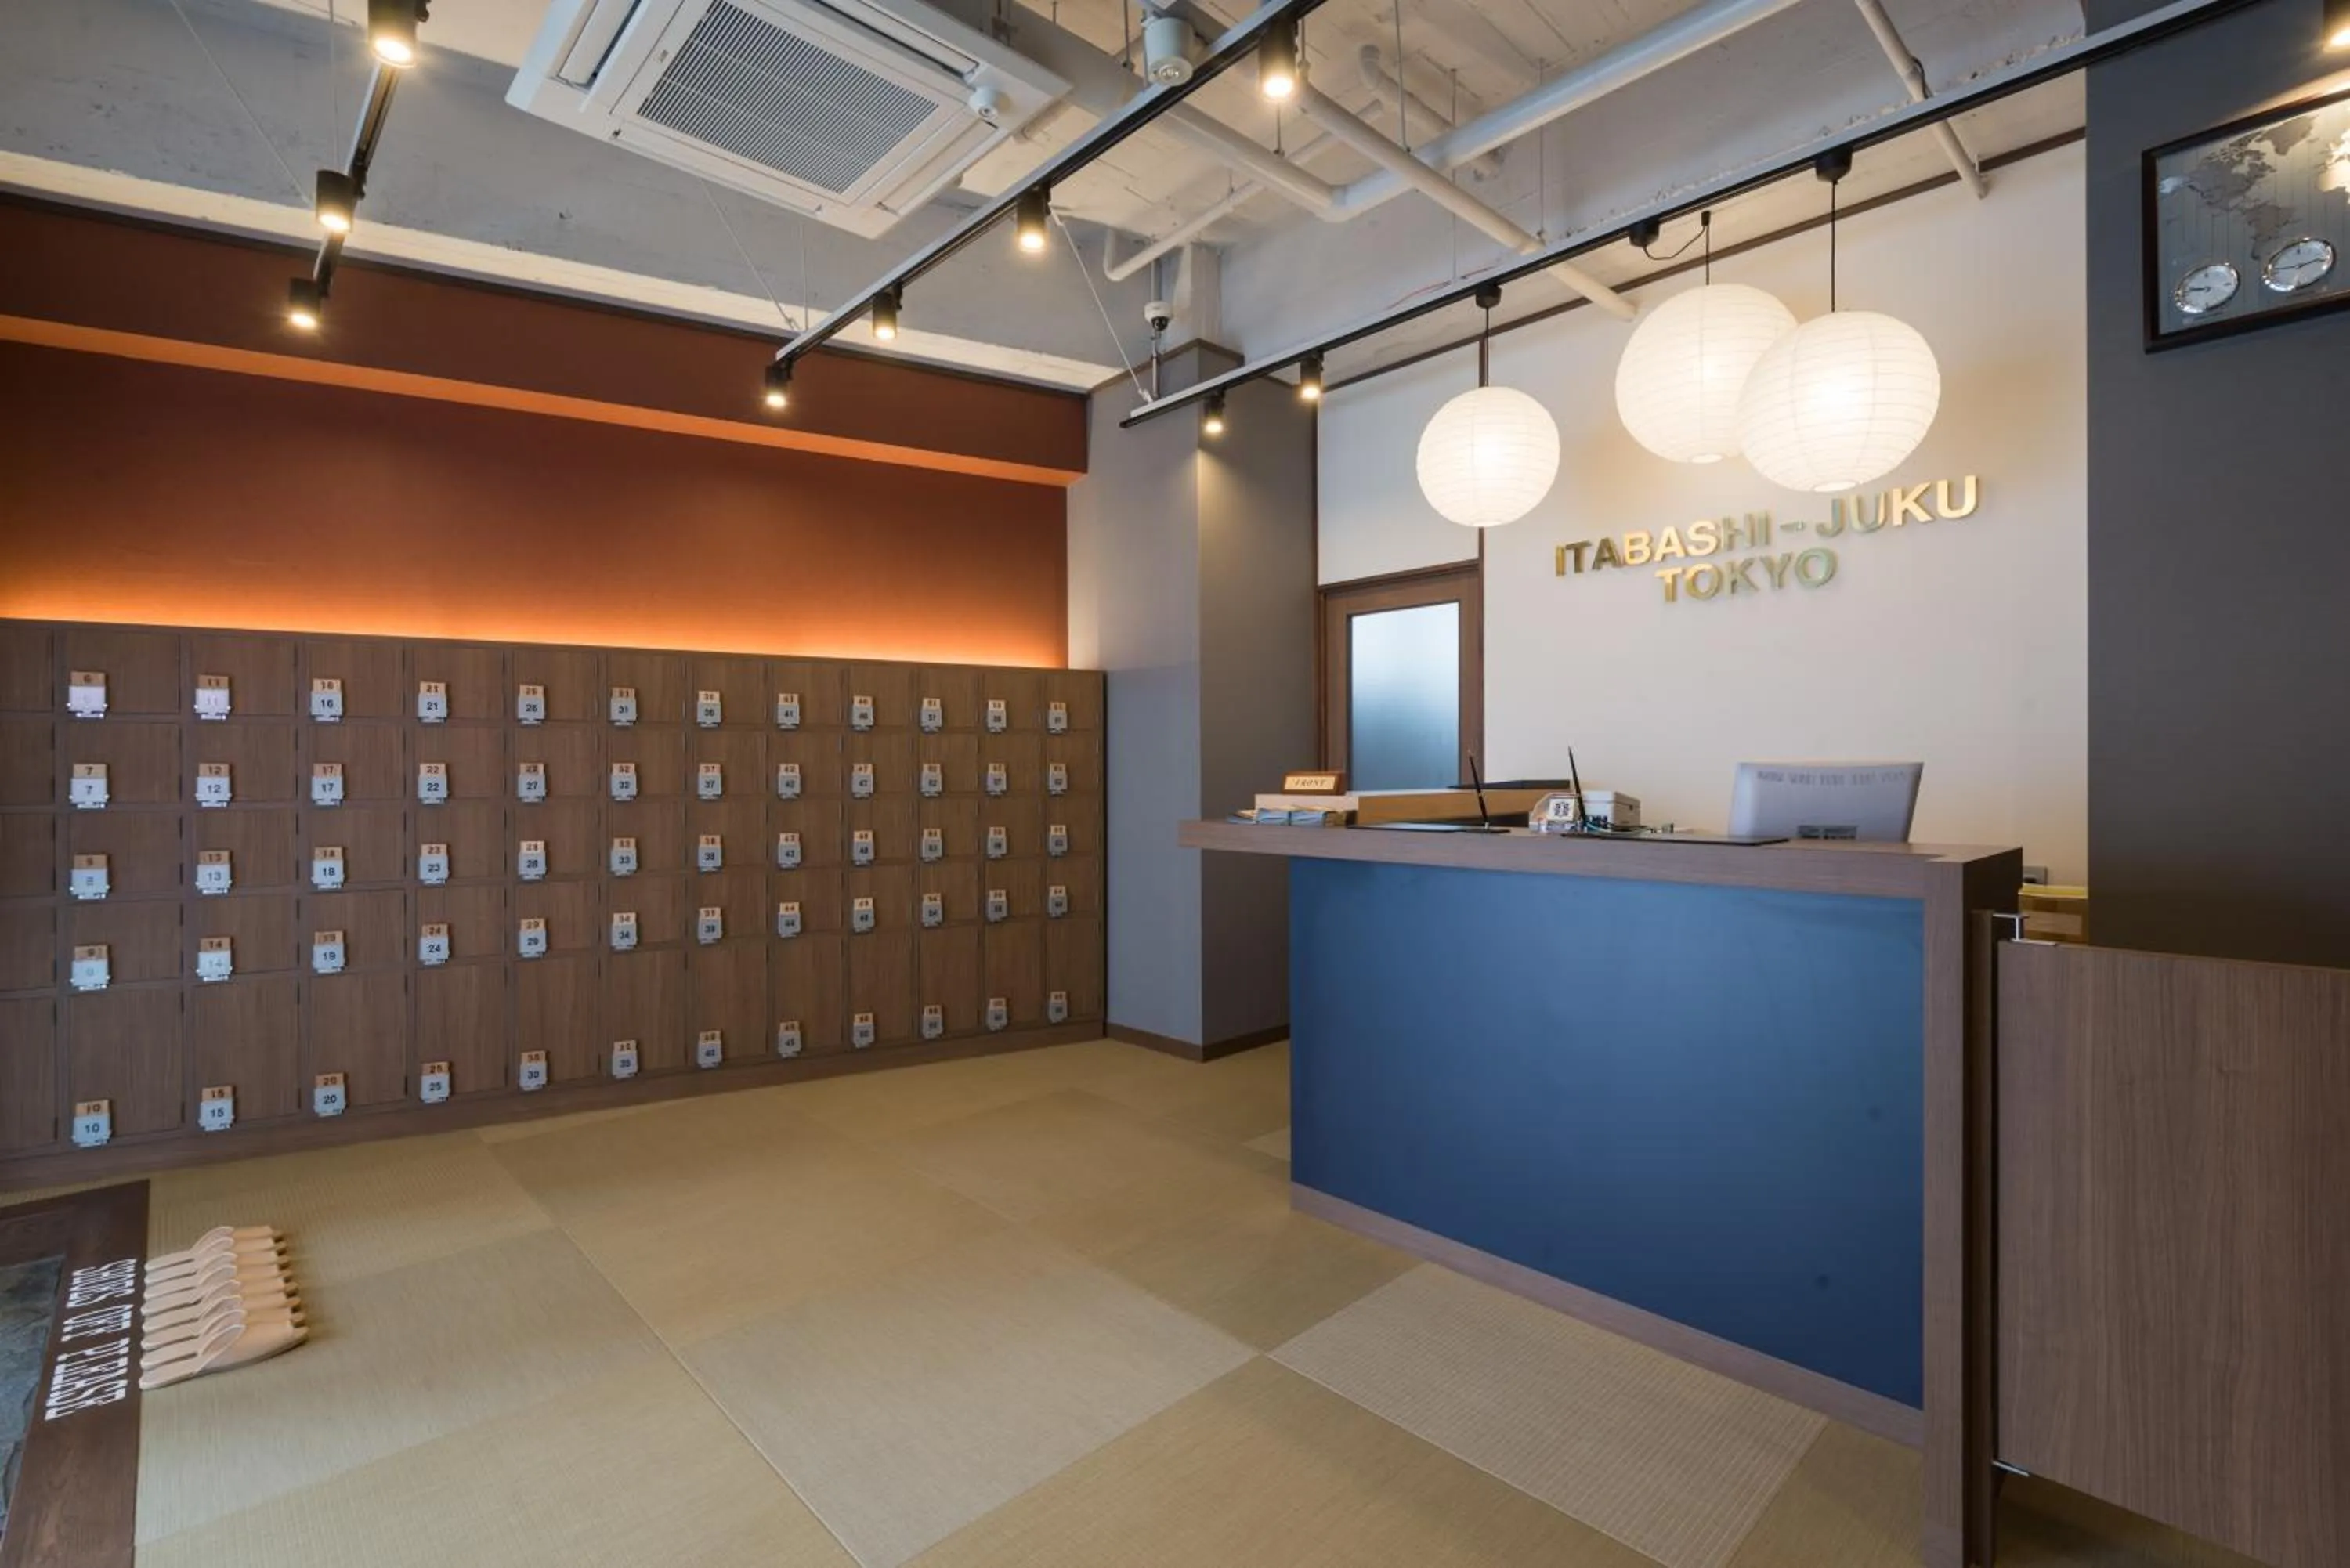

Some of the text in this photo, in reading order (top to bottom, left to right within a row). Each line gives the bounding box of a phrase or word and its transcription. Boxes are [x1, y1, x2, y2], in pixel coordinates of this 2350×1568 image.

[1654, 547, 1837, 604] TOKYO
[427, 702, 437, 710] 21
[322, 783, 334, 792] 17
[1294, 779, 1326, 787] FRONT
[86, 786, 92, 794] 7
[208, 785, 221, 793] 12
[324, 867, 335, 876] 18
[428, 864, 440, 873] 23
[208, 872, 221, 881] 13
[324, 952, 336, 960] 19
[324, 1095, 337, 1104] 20
[211, 1108, 224, 1117] 15
[85, 1123, 99, 1133] 10
[61, 1304, 134, 1342] OFF
[45, 1337, 130, 1421] PLEASE
